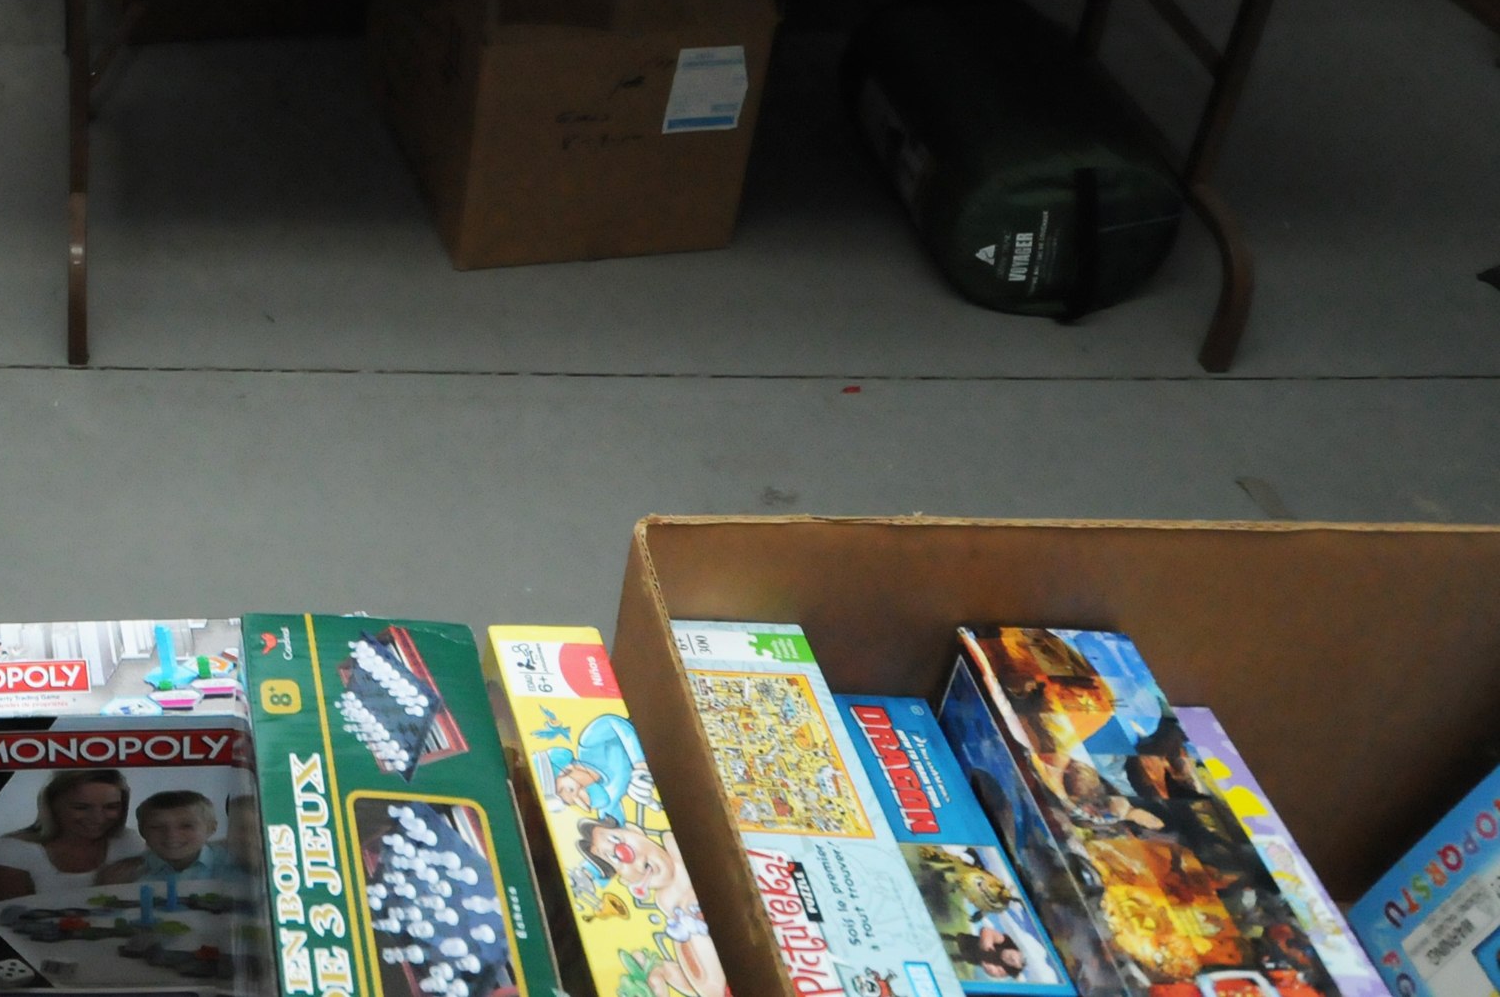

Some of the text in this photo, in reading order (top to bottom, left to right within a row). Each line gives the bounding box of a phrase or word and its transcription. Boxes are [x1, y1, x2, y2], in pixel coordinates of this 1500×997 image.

[1008, 232, 1034, 282] VOYAGER
[695, 635, 713, 655] 300
[268, 685, 293, 708] 8+
[538, 675, 554, 694] 6+
[850, 704, 941, 835] DRAGON
[288, 752, 343, 897] JEUX
[267, 823, 315, 996] EN BOIS
[309, 902, 347, 940] 3
